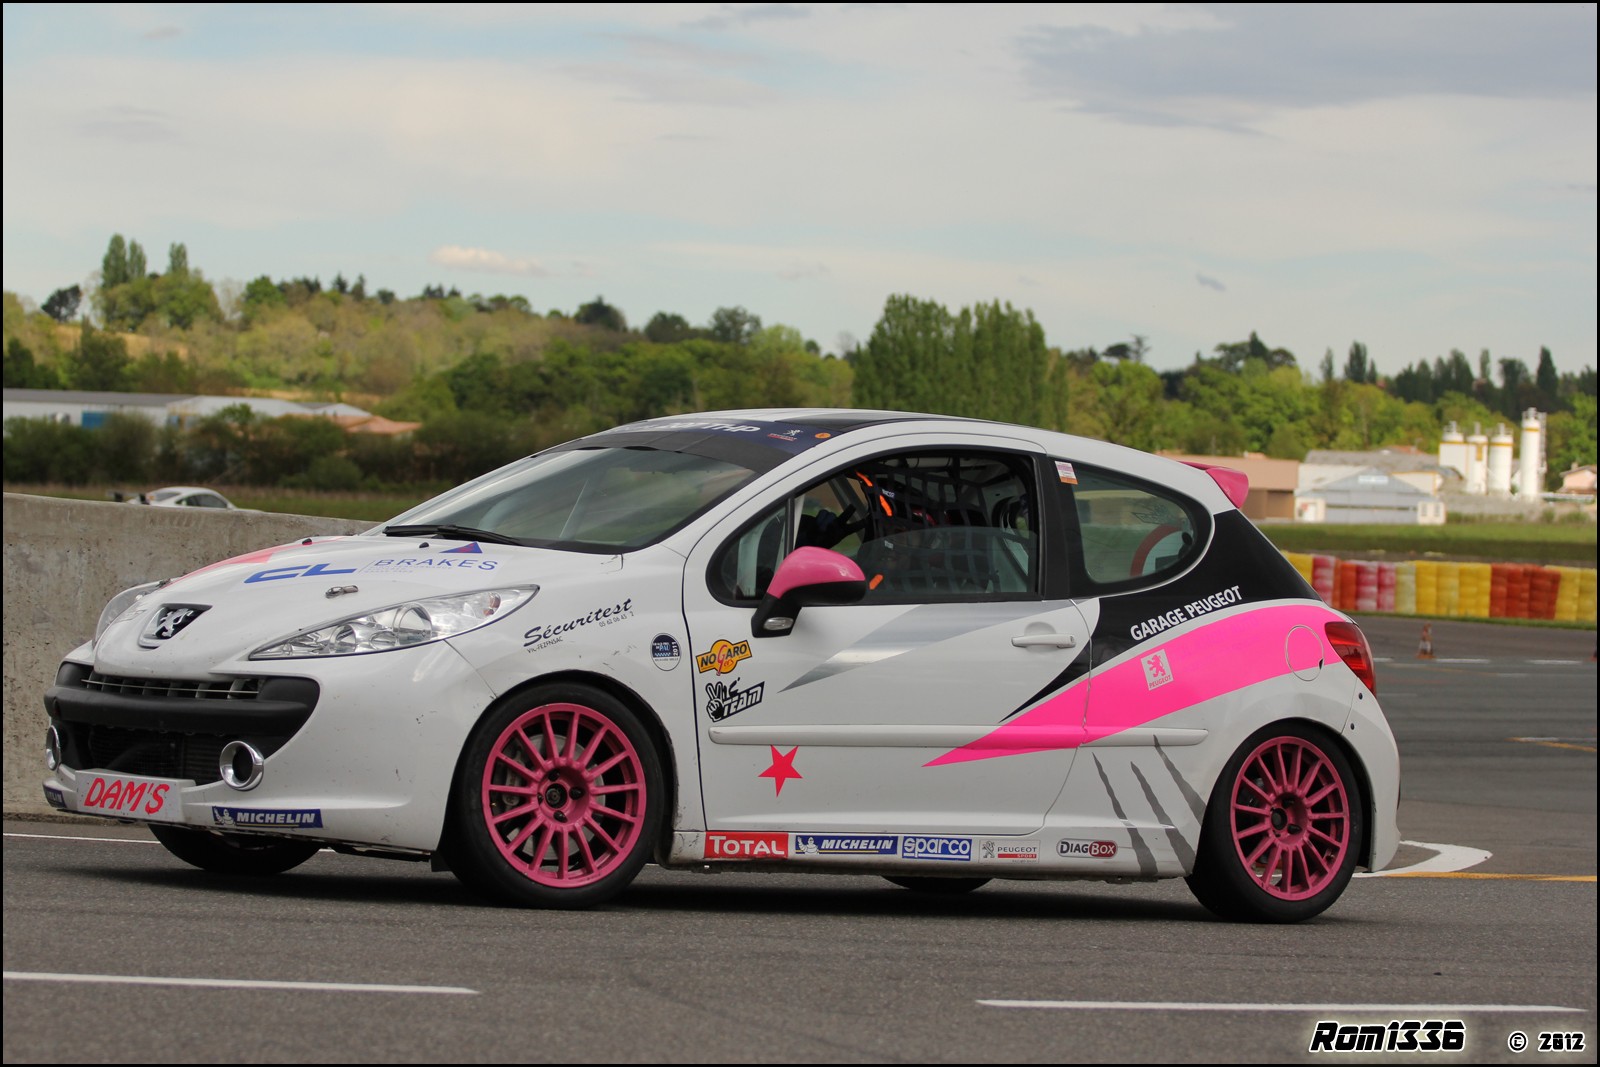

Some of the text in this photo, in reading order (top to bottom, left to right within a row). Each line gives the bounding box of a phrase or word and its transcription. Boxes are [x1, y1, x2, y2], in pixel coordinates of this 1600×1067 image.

[243, 563, 357, 584] CL
[375, 558, 498, 571] BRAKES
[523, 598, 632, 647] Sécuritest
[1130, 585, 1243, 641] GARAGE PEUGEOT
[701, 643, 748, 670] NOGARO
[1149, 674, 1172, 689] PEUGEOT
[84, 777, 170, 814] DAM'S
[236, 811, 316, 824] MICHELIN
[709, 836, 785, 855] TOTAL
[820, 839, 894, 850] MICHELIN
[904, 837, 970, 858] sparco
